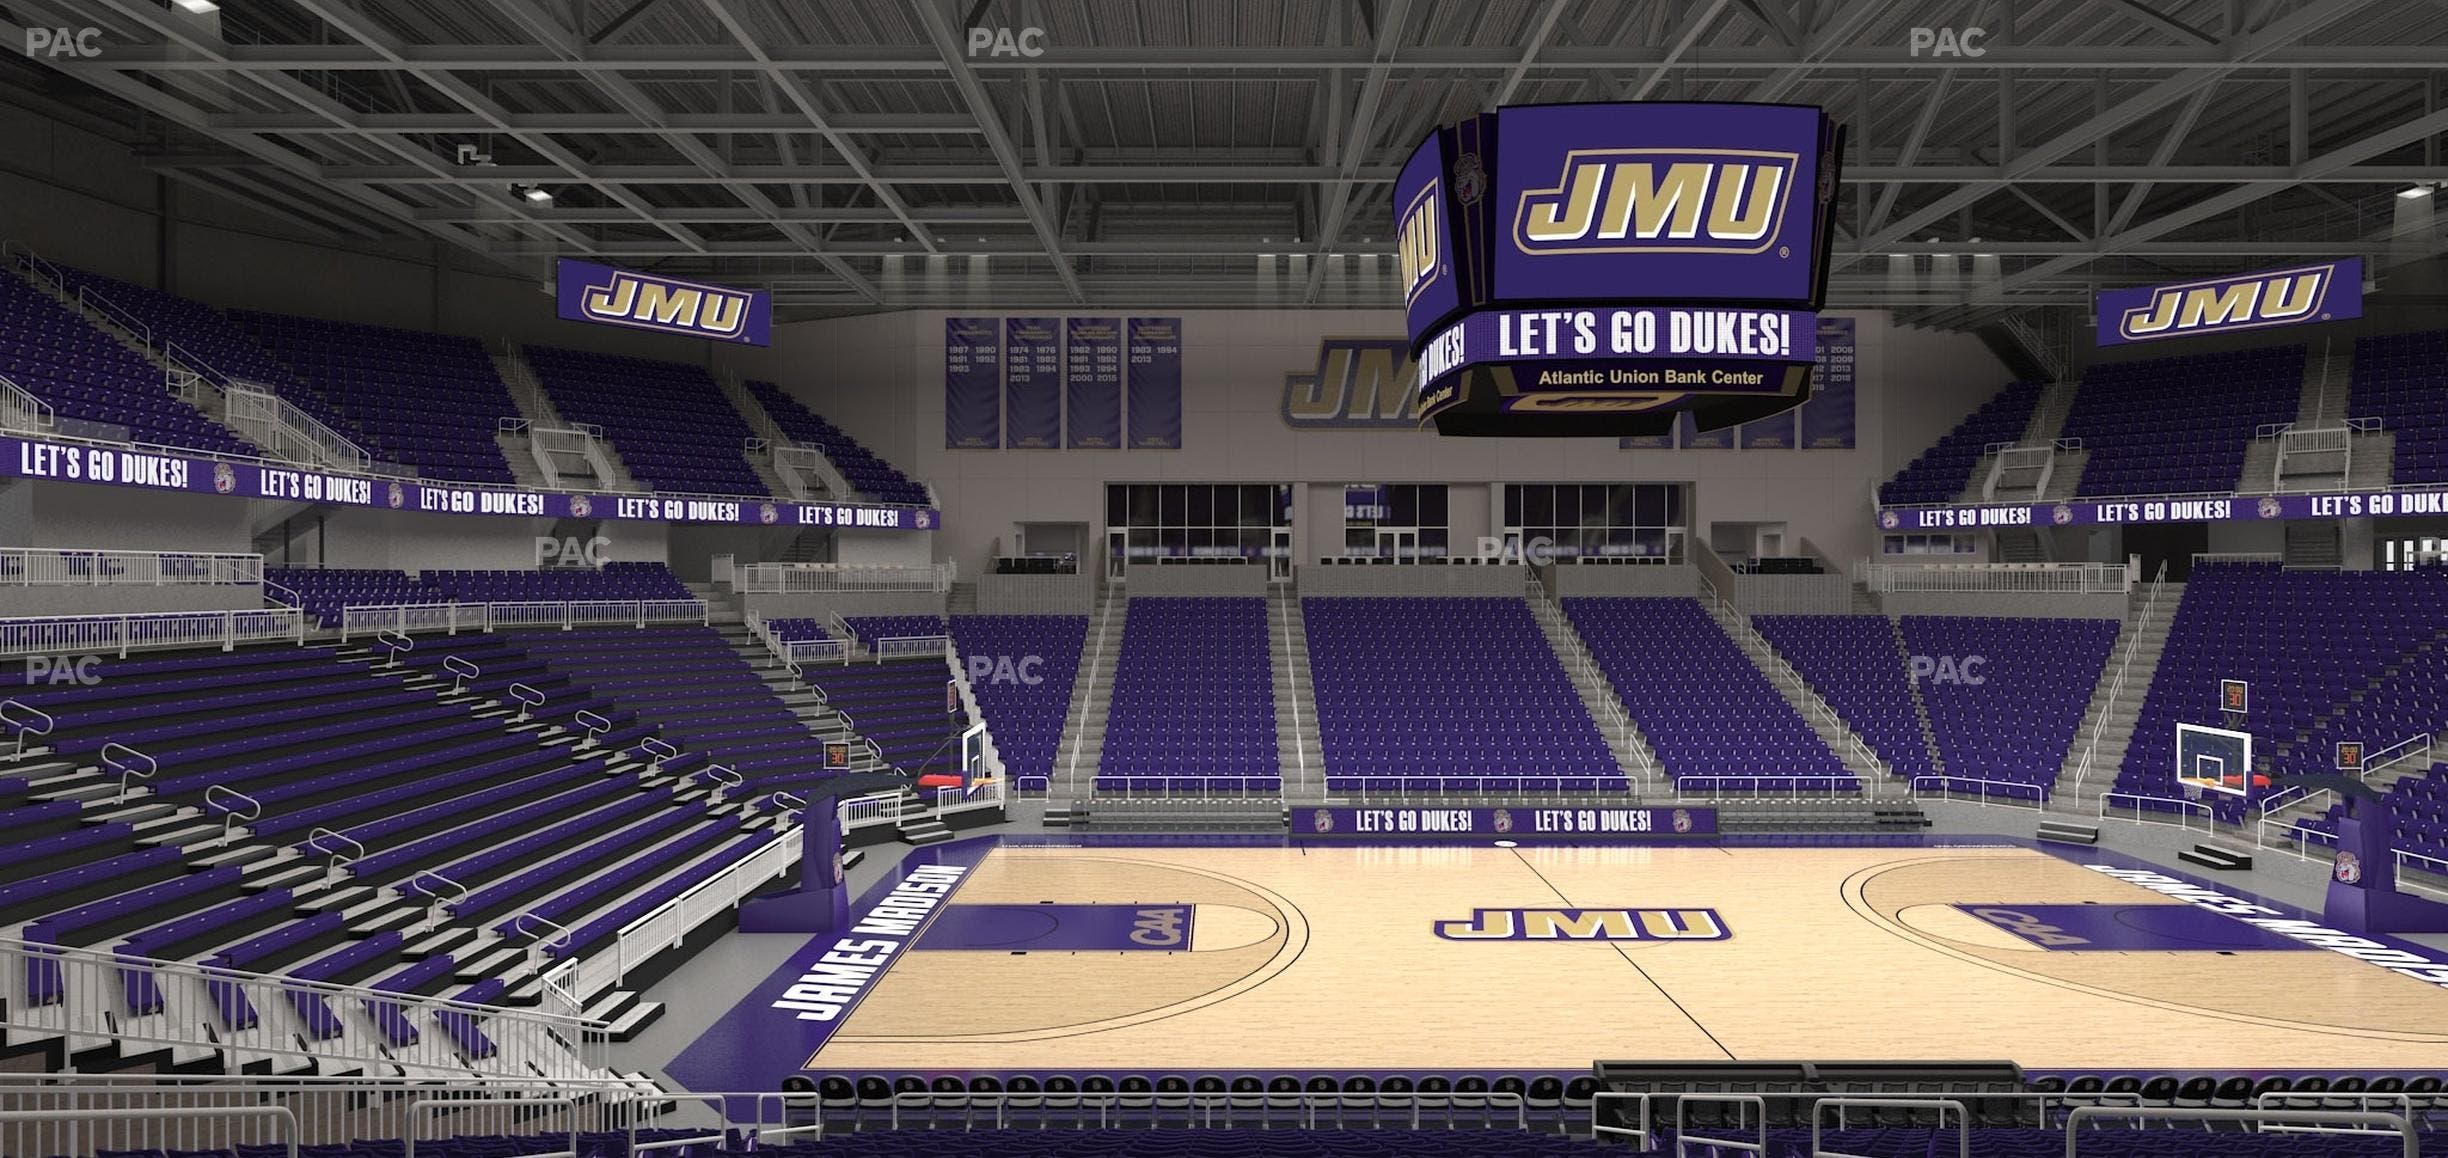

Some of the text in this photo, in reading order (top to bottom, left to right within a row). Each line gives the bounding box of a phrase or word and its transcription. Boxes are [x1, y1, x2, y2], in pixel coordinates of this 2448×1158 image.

[1525, 162, 1784, 242] JMU
[590, 278, 744, 333] JMU
[2128, 272, 2322, 335] JMU
[1499, 311, 1789, 356] LET'S GO DUKES!
[1428, 323, 1465, 382] DUKES!
[1288, 348, 1421, 420] JM
[1539, 369, 1764, 385] Atlantic Union Bank Center
[21, 441, 188, 489] LET'S GO DUKES!
[260, 469, 371, 505] LET'S GO DUKES!
[420, 487, 544, 515] LET'S GO DUKES!
[618, 498, 739, 522] LET'S GO DUKES!
[799, 506, 899, 527] LET'S GO DUKES!
[1919, 507, 2031, 527] LET'S GO DUKES!
[2097, 500, 2231, 522] LET'S GO DUKES!
[2312, 495, 2362, 516] LET'S
[2368, 494, 2394, 515] GO
[2229, 693, 2241, 706] 30
[831, 753, 845, 764] 30
[2343, 753, 2357, 764] 30
[1356, 810, 1472, 832] LET'S GO DUKES!
[1535, 810, 1652, 832] LET'S GO DUKES!
[2083, 864, 2284, 915] JAMES
[1129, 908, 1184, 946] CAA
[1441, 908, 1724, 940] JMU
[1972, 908, 2092, 946] CAA
[771, 864, 968, 1022] JAMES MADISON
